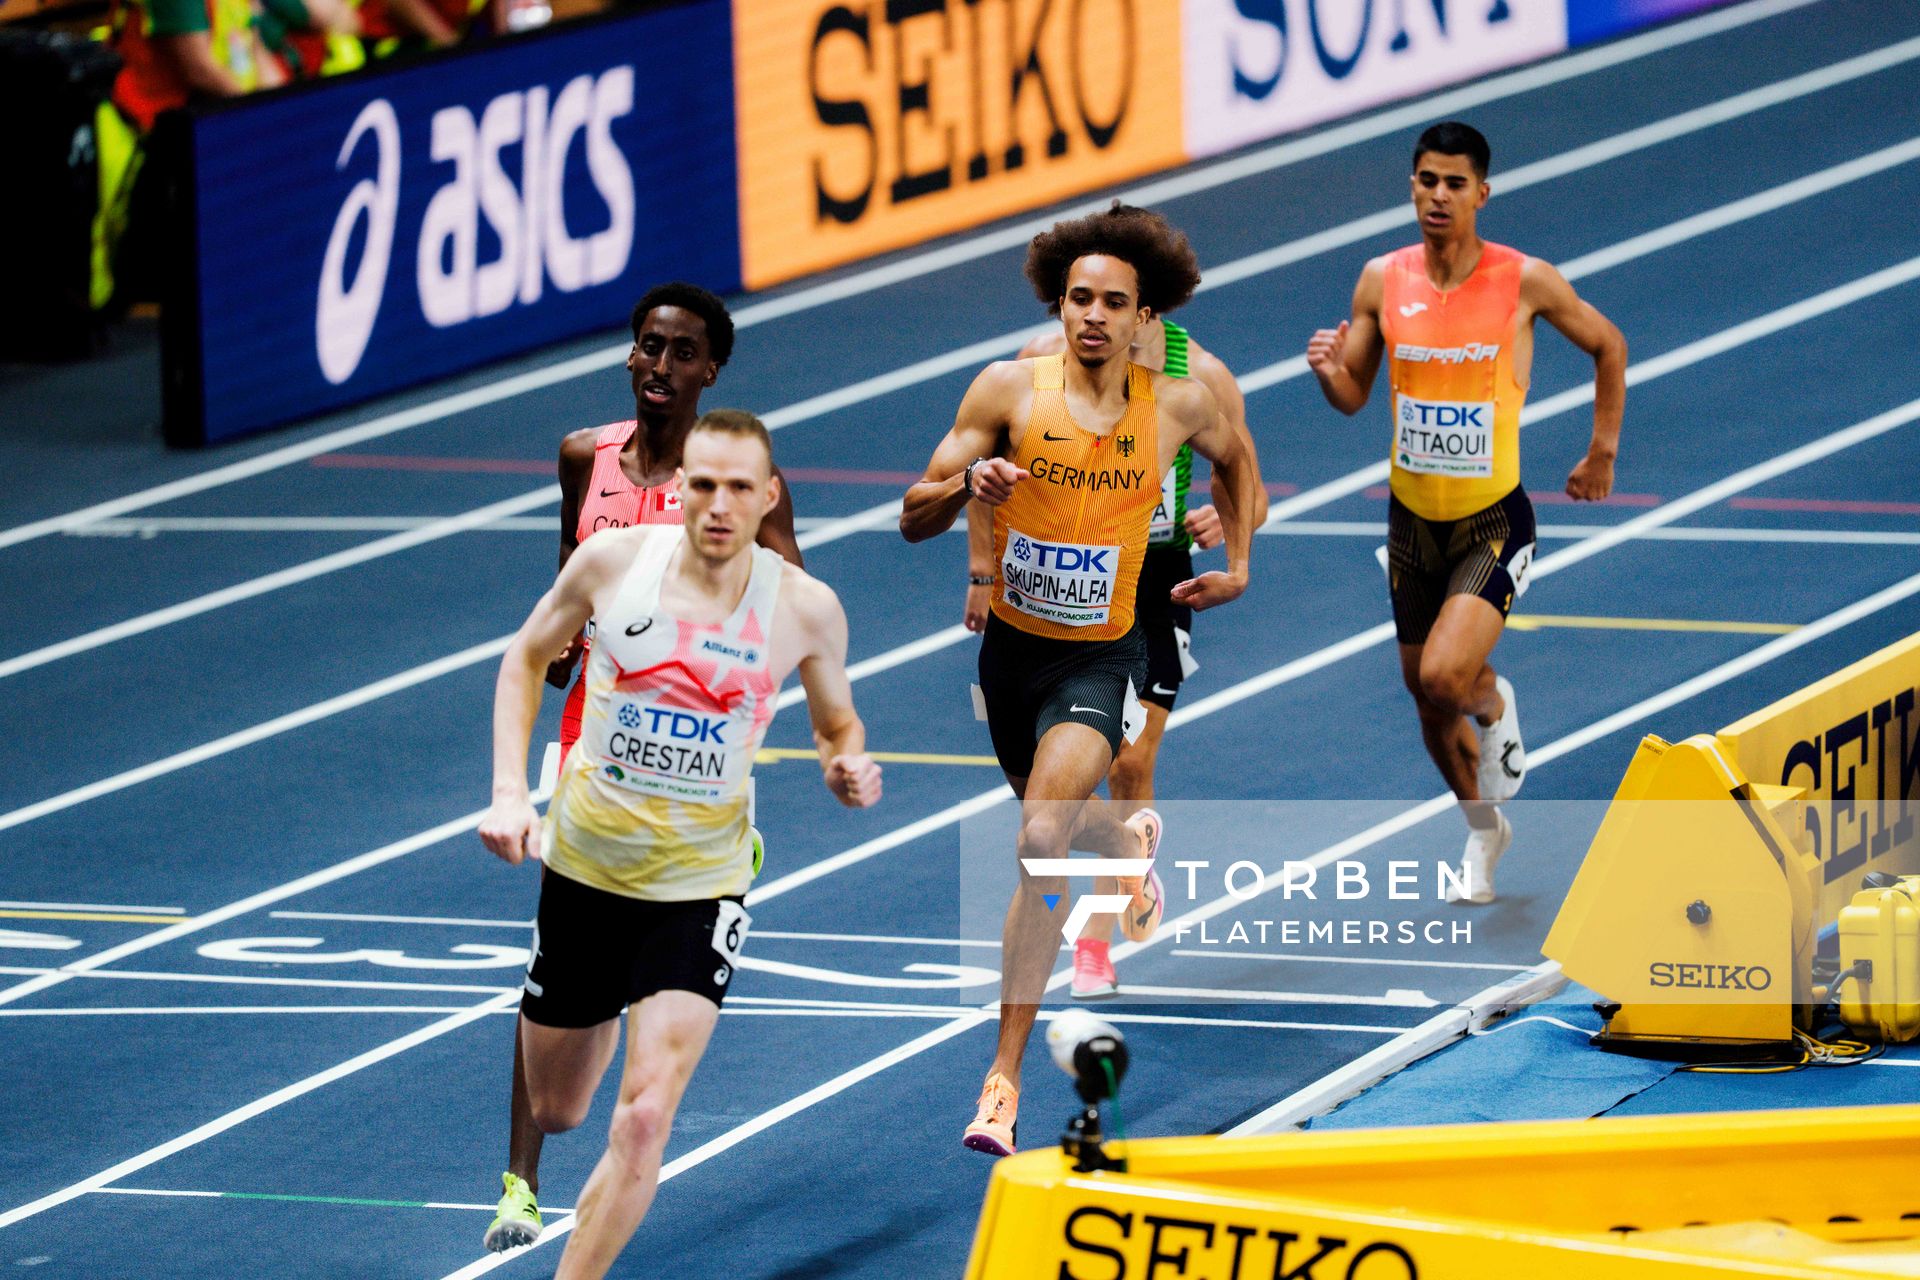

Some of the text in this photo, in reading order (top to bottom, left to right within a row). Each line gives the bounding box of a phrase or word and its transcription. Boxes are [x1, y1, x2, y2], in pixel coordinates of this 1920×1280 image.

[1394, 342, 1501, 365] ESPAÑA
[1414, 404, 1483, 427] TDK
[1400, 427, 1487, 456] ATTAOUI
[1029, 457, 1146, 492] GERMANY
[1031, 543, 1110, 573] TDK
[1005, 562, 1108, 604] SKUPIN-ALFA
[1026, 602, 1056, 617] KUJAWY
[1057, 610, 1094, 621] POMORZE
[703, 640, 742, 659] Allianz
[644, 707, 729, 745] TDK
[609, 731, 726, 778] CRESTAN
[726, 917, 742, 953] 6
[1649, 963, 1772, 991] SEIKO
